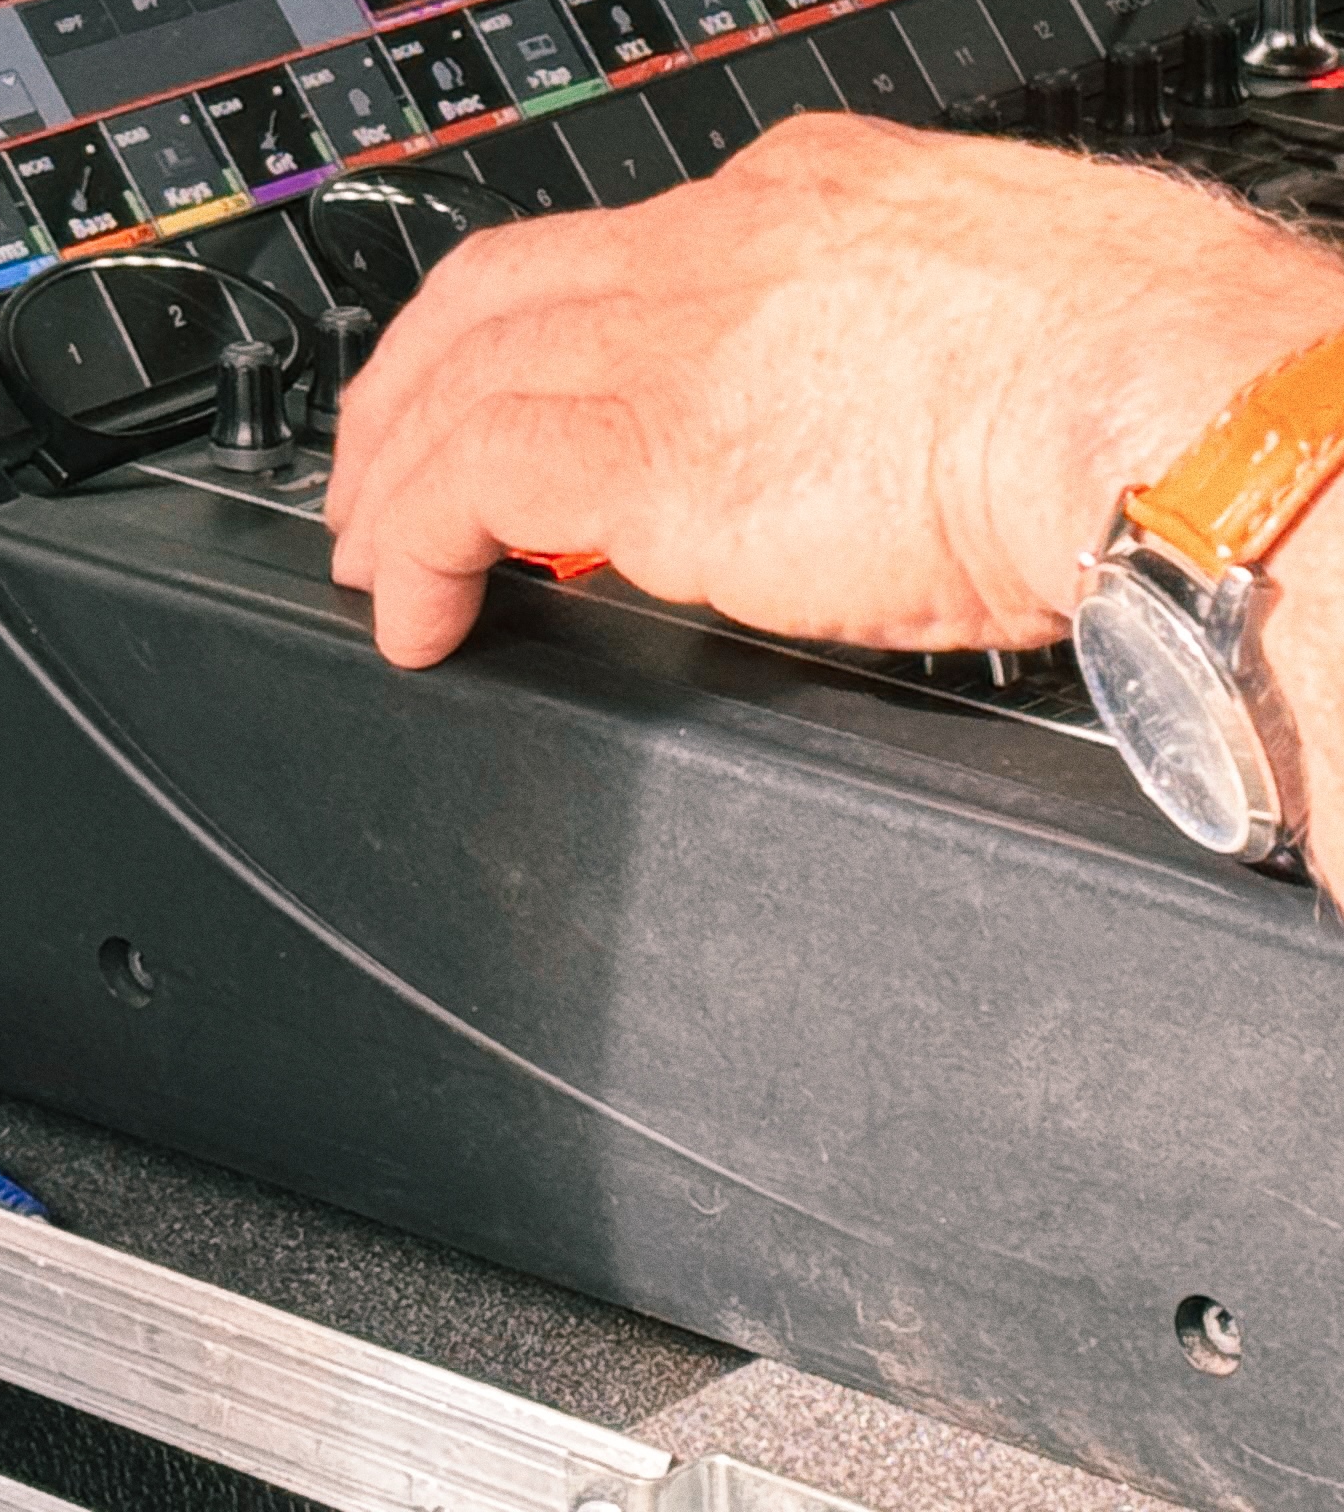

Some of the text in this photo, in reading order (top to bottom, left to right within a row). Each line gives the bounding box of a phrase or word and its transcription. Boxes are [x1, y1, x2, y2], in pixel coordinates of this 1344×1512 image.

[699, 10, 736, 36] VX2
[1033, 20, 1054, 40] 12
[615, 38, 653, 63] VX1
[872, 74, 895, 94] 10
[351, 122, 391, 147] Voc
[708, 129, 726, 150] 8
[264, 151, 299, 176] Git
[622, 159, 638, 180] 7
[162, 179, 214, 209] Keys
[536, 188, 552, 208] 6
[67, 210, 118, 240] Bass
[167, 305, 188, 329] 2
[69, 342, 83, 365] 1
